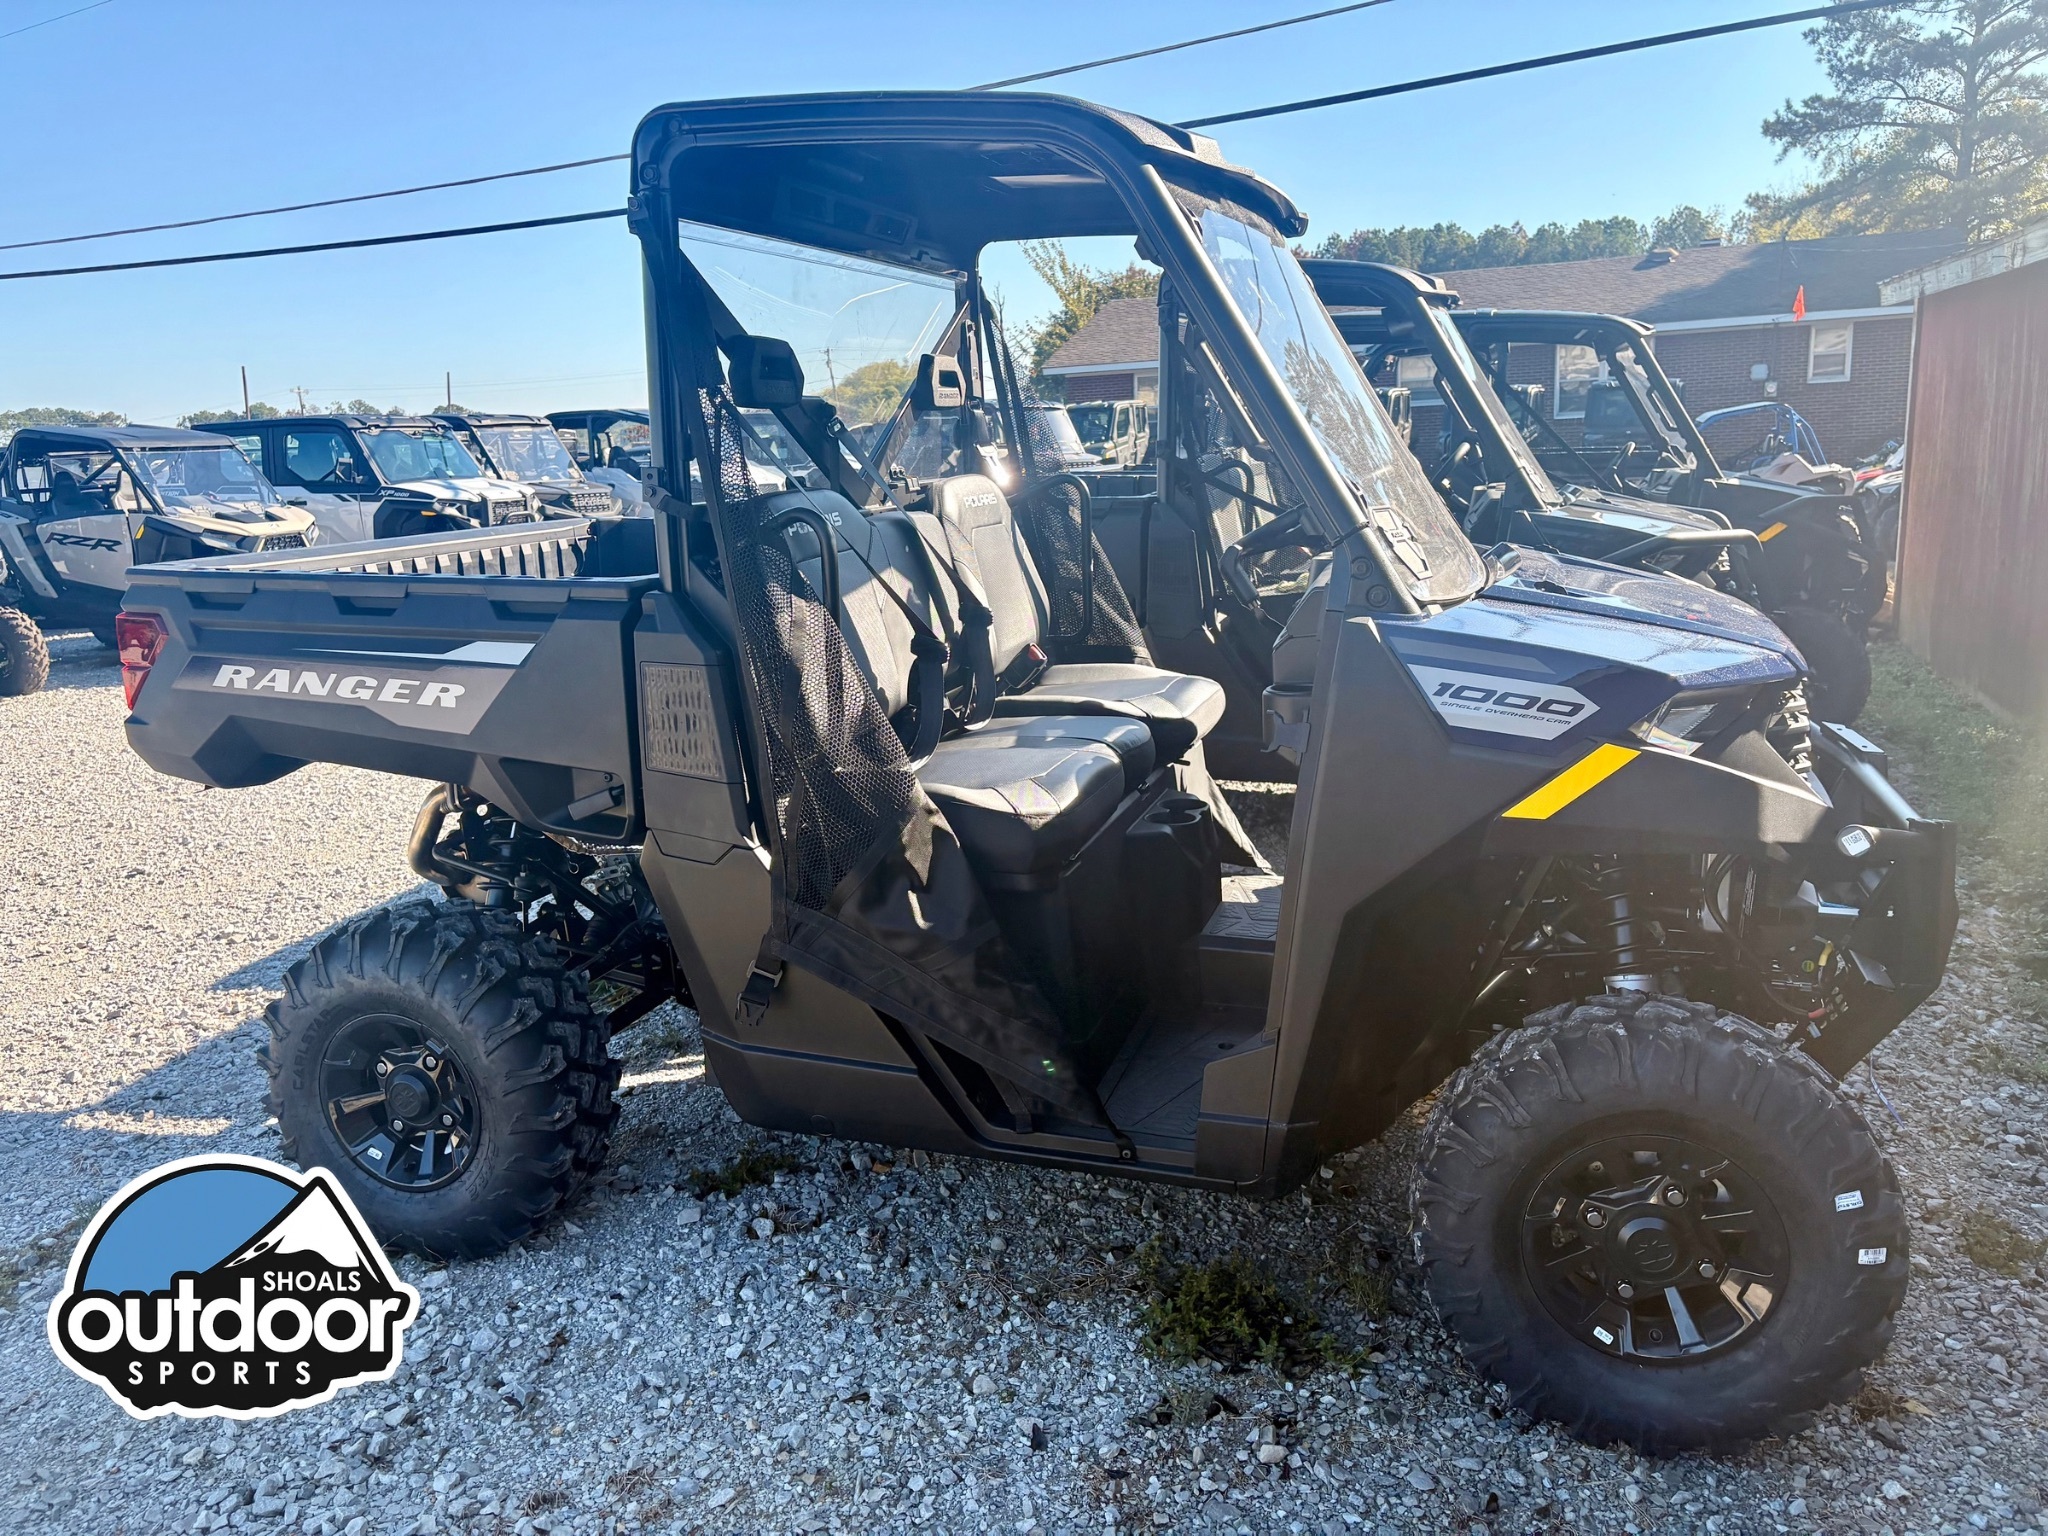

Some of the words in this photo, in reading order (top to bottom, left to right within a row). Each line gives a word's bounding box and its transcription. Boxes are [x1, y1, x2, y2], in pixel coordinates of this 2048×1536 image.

[963, 492, 998, 508] POLARIS
[45, 532, 122, 552] RZR
[212, 664, 466, 708] RANGER
[1432, 681, 1586, 717] 1000
[1439, 701, 1481, 711] SINGLE
[1485, 708, 1545, 721] OVERHEAD
[1546, 717, 1572, 726] CAM
